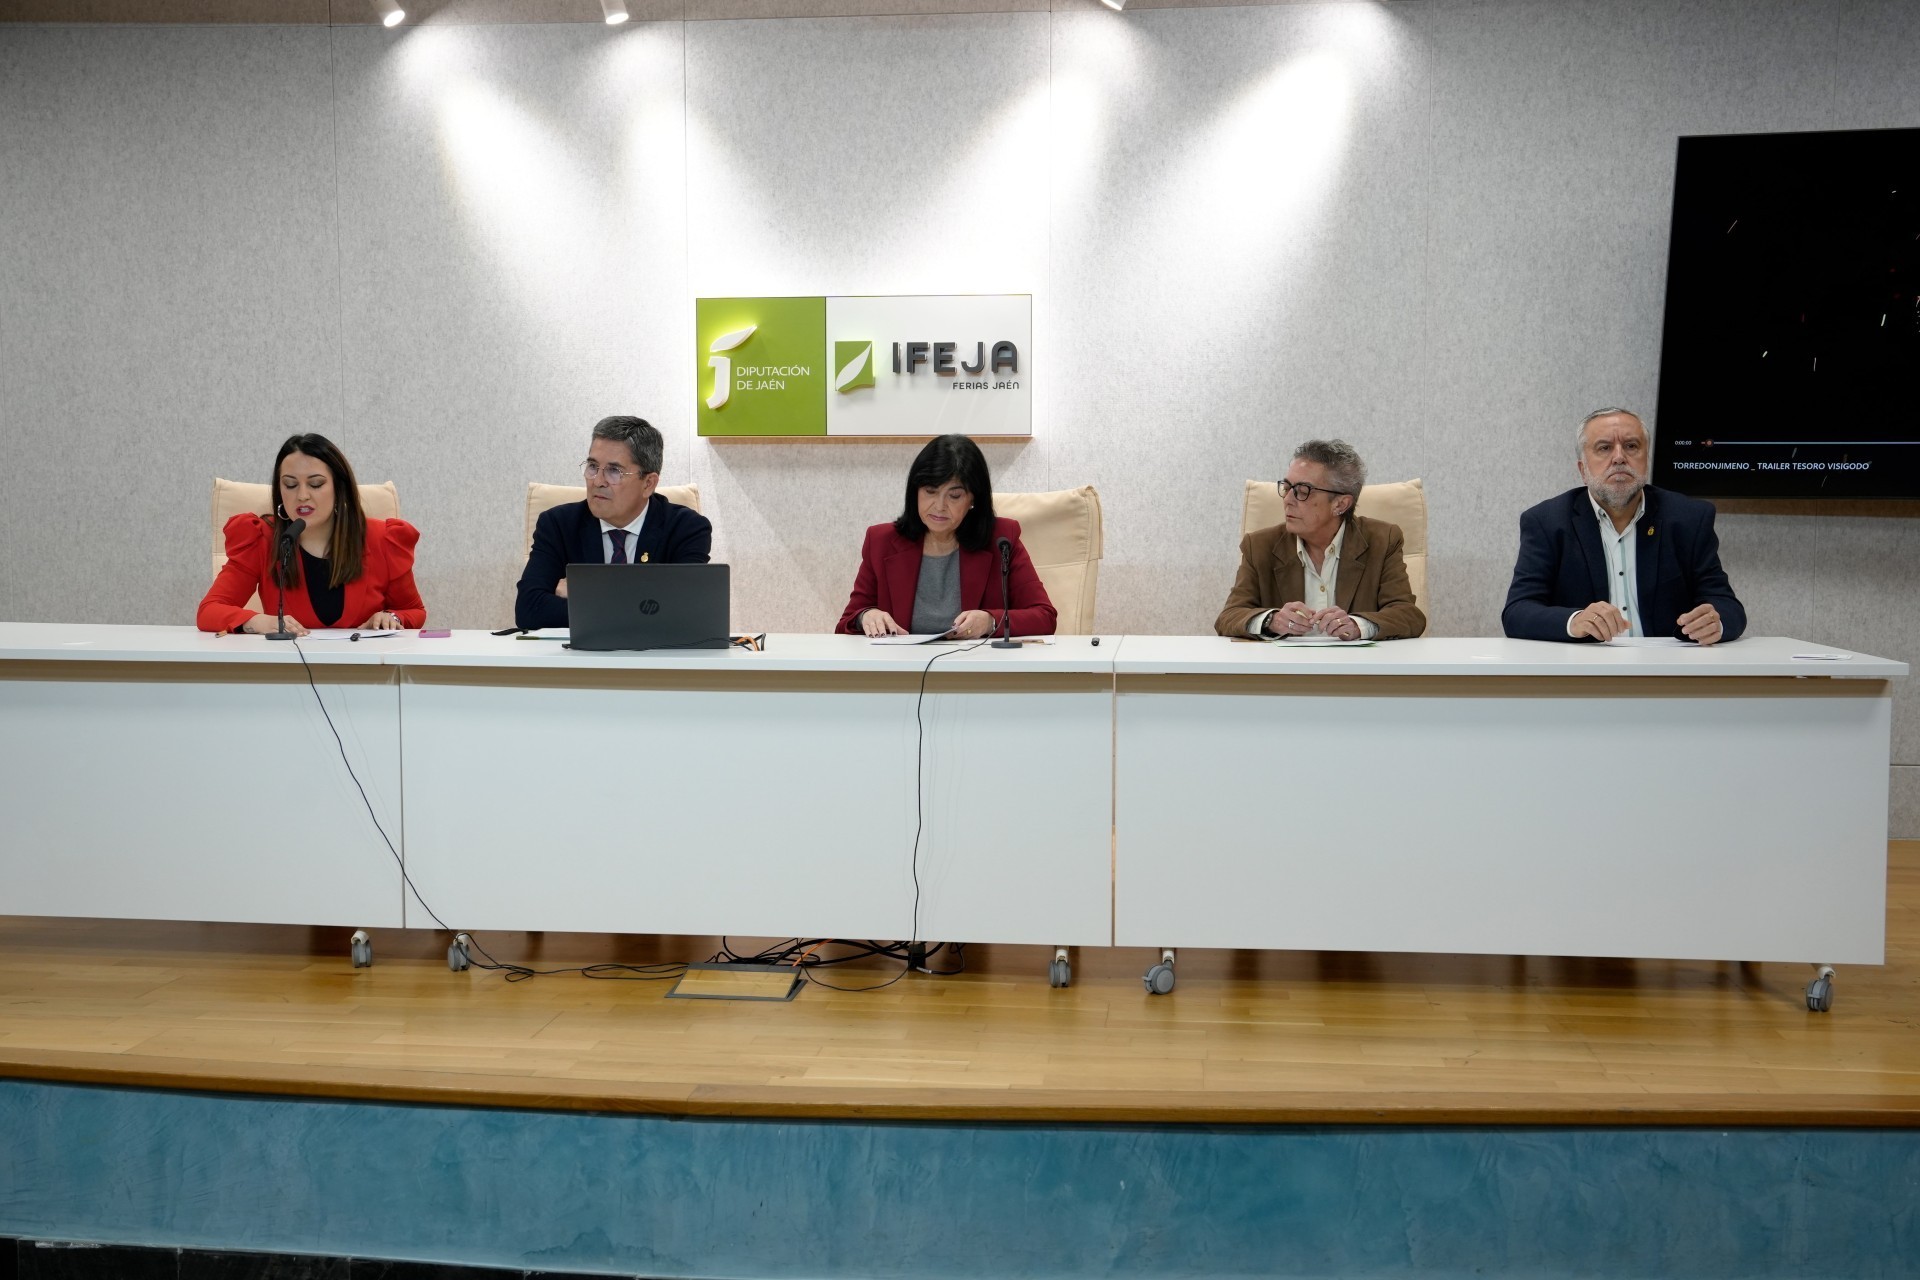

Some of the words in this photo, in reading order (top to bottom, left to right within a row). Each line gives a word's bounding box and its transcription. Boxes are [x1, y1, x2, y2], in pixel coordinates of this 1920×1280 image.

[892, 340, 1018, 373] IFEJA
[736, 364, 810, 377] DIPUTACIÓN
[736, 380, 753, 390] DE
[755, 379, 785, 390] JAÉN
[952, 382, 989, 390] FERIAS
[1673, 462, 1750, 470] TORREDONJIMENO
[1757, 462, 1790, 470] TRAILER
[1792, 462, 1826, 470] TESORO
[1827, 462, 1870, 470] VISIGODO
